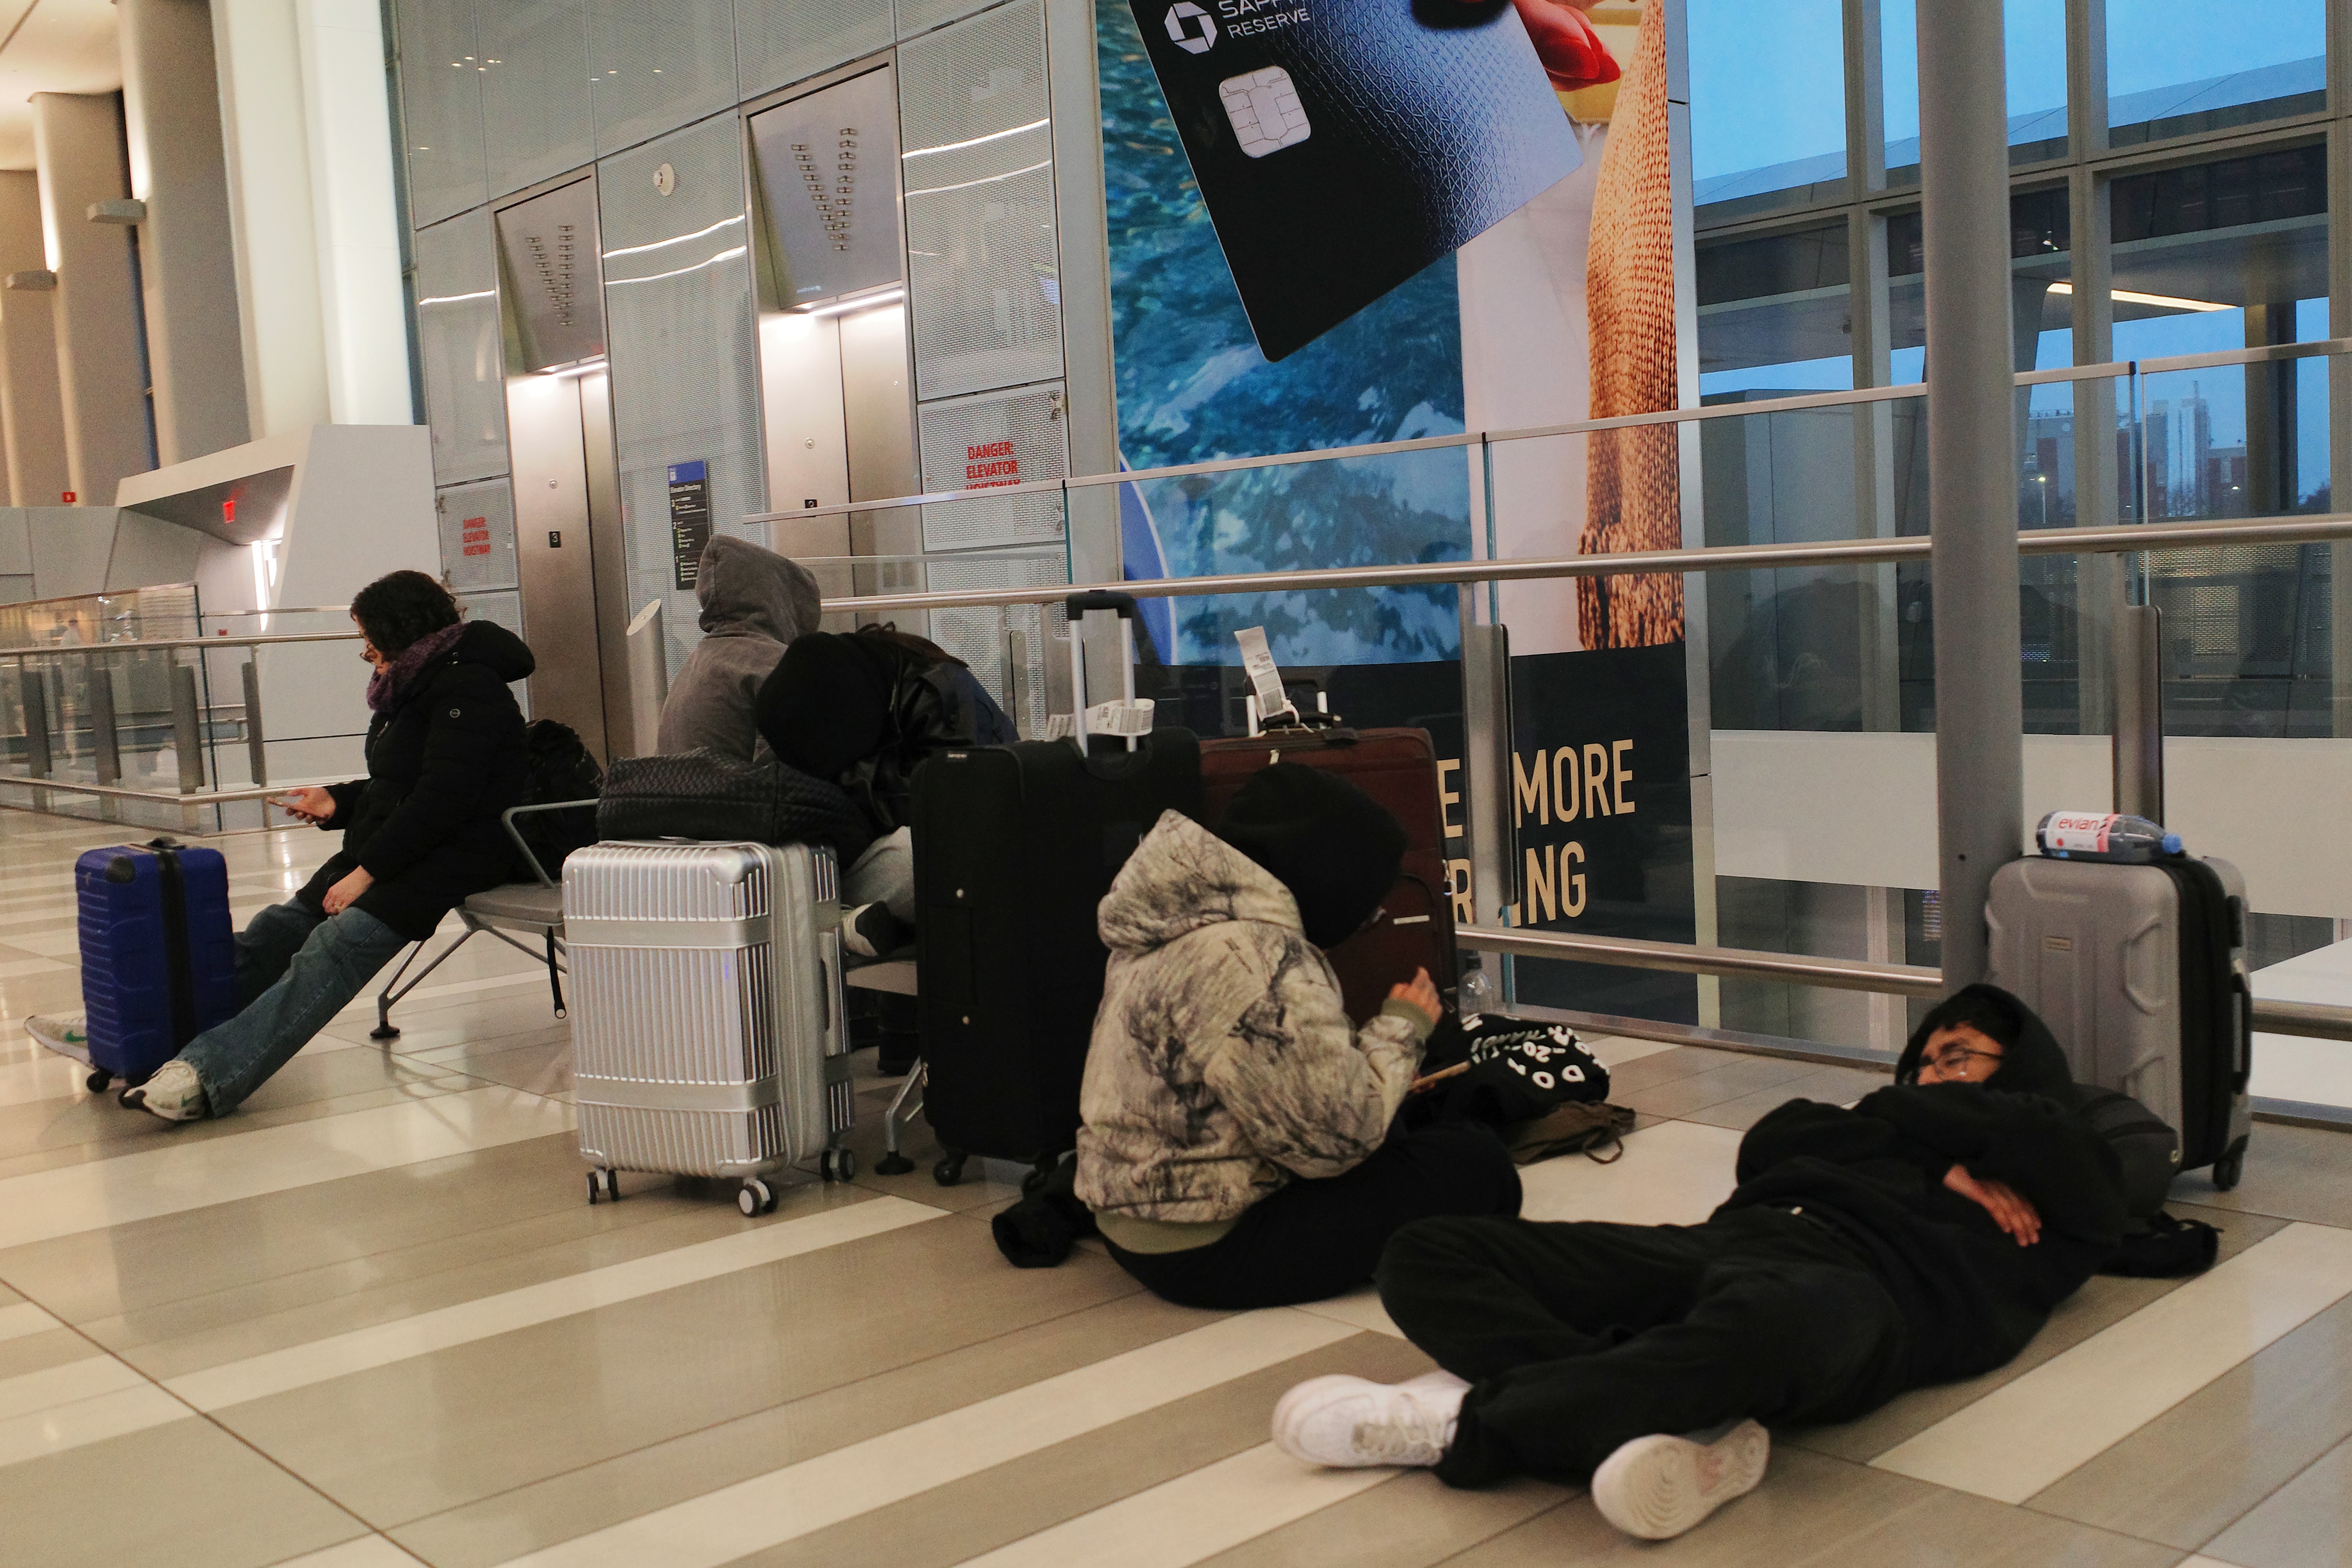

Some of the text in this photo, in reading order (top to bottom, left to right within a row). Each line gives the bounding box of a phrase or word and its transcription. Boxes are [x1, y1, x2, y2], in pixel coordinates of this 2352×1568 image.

[1227, 8, 1311, 39] RESERVE
[967, 441, 1014, 460] DANGER
[966, 460, 1018, 479] ELEVATOR
[552, 532, 558, 543] 3
[1513, 739, 1635, 829] MORE
[2058, 818, 2099, 830] evian
[1448, 841, 1586, 926] RNG
